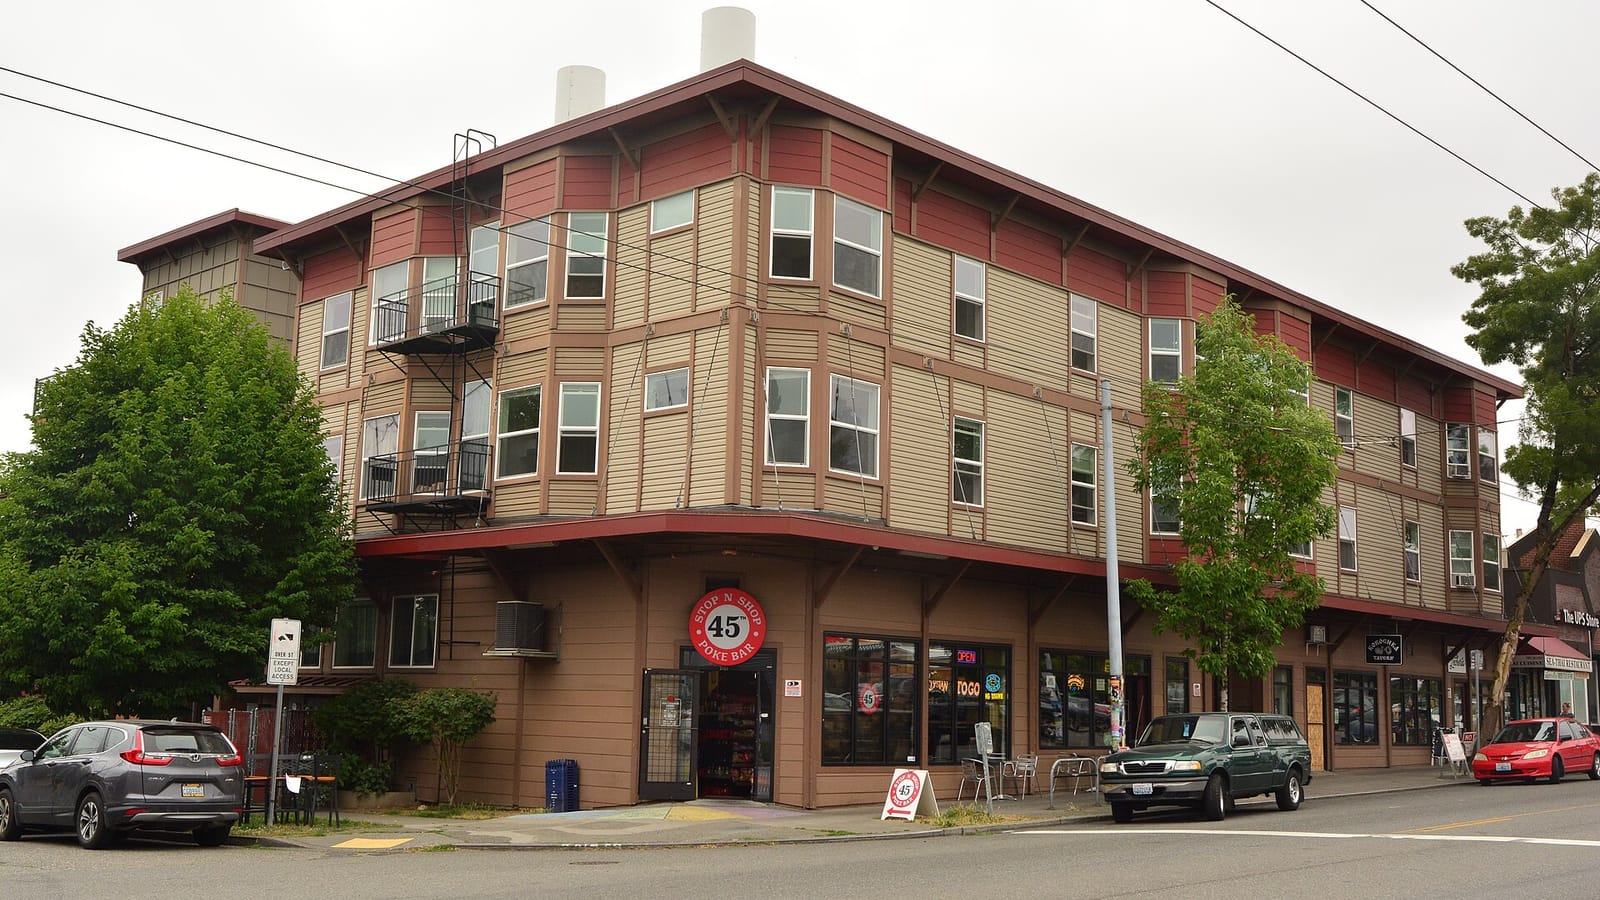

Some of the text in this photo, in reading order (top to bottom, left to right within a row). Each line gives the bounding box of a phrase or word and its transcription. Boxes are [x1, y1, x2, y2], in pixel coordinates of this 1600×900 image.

[694, 593, 762, 625] STOP N SHOP
[1563, 608, 1574, 624] The
[1574, 610, 1586, 626] UPS
[1585, 613, 1600, 628] Store
[698, 639, 755, 662] POKE BAR
[957, 651, 976, 662] OPEN
[1566, 659, 1590, 670] RESTAURANT
